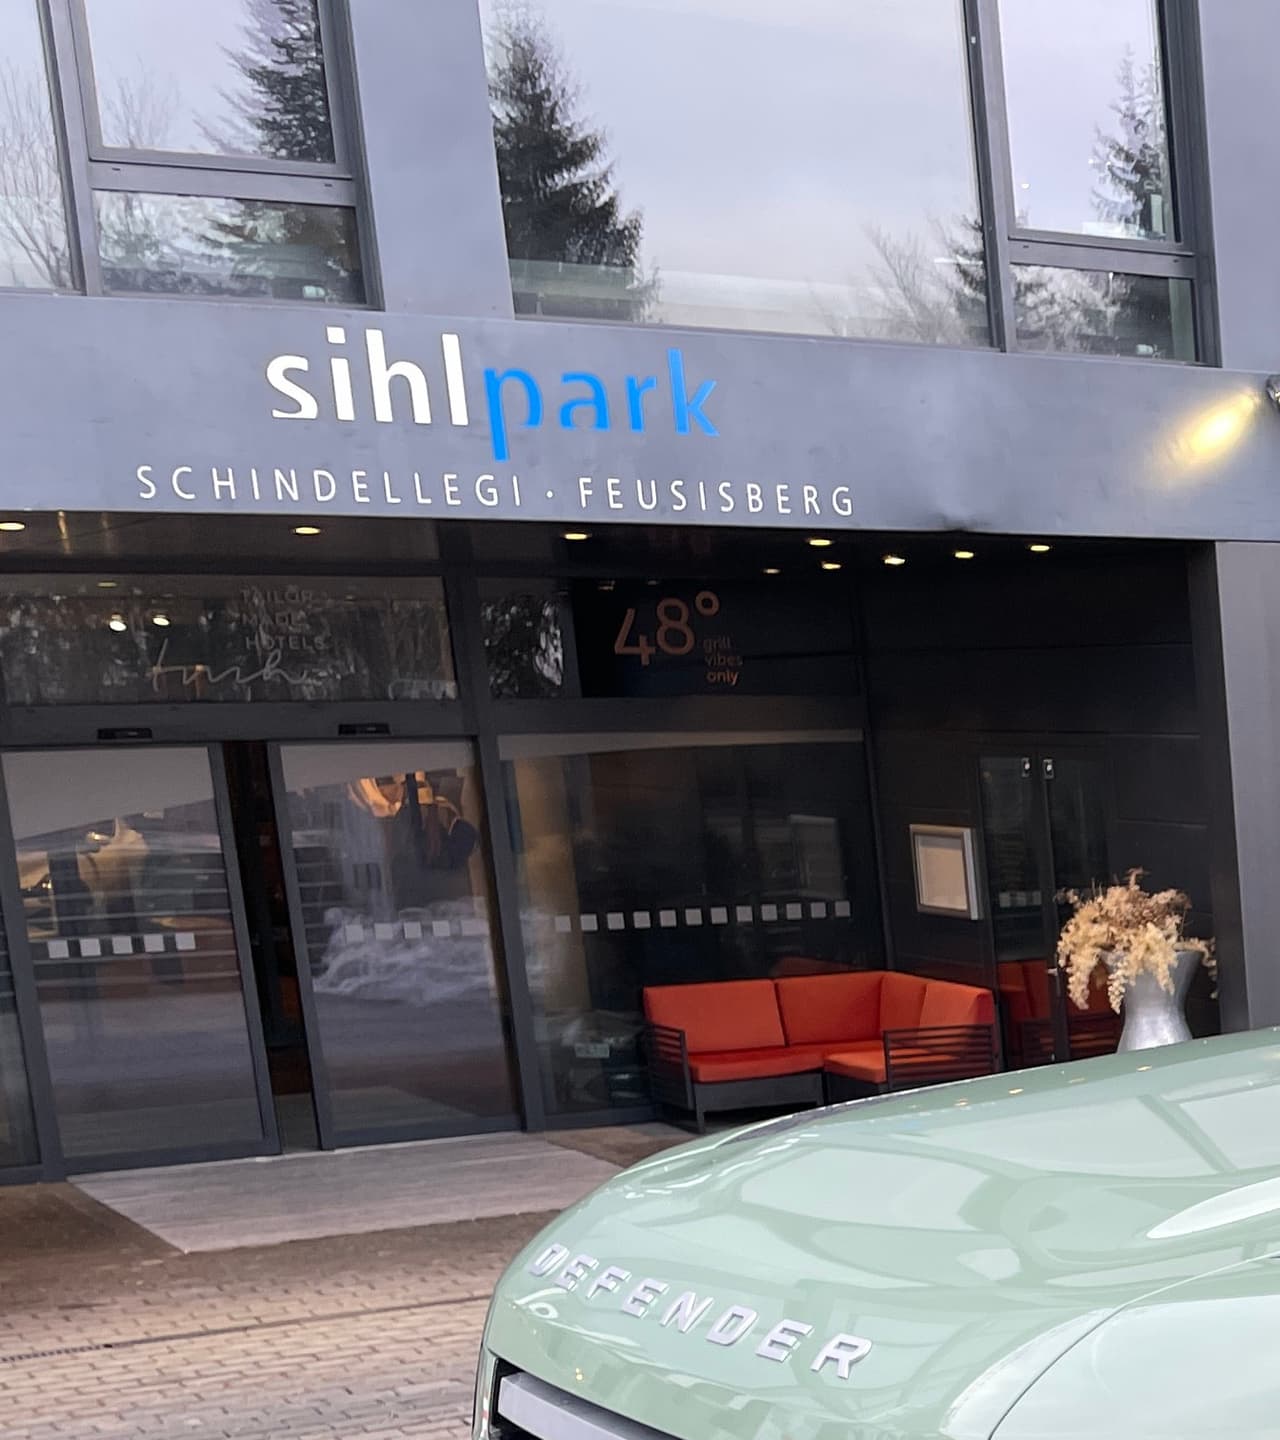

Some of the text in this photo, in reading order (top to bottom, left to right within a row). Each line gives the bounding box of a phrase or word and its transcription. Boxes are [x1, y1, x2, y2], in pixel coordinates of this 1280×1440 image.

[266, 325, 720, 461] sihlpark
[135, 464, 855, 517] SCHINDELLEGI FEUSISBERG
[706, 668, 740, 686] only
[527, 1243, 873, 1379] DEFENDER
